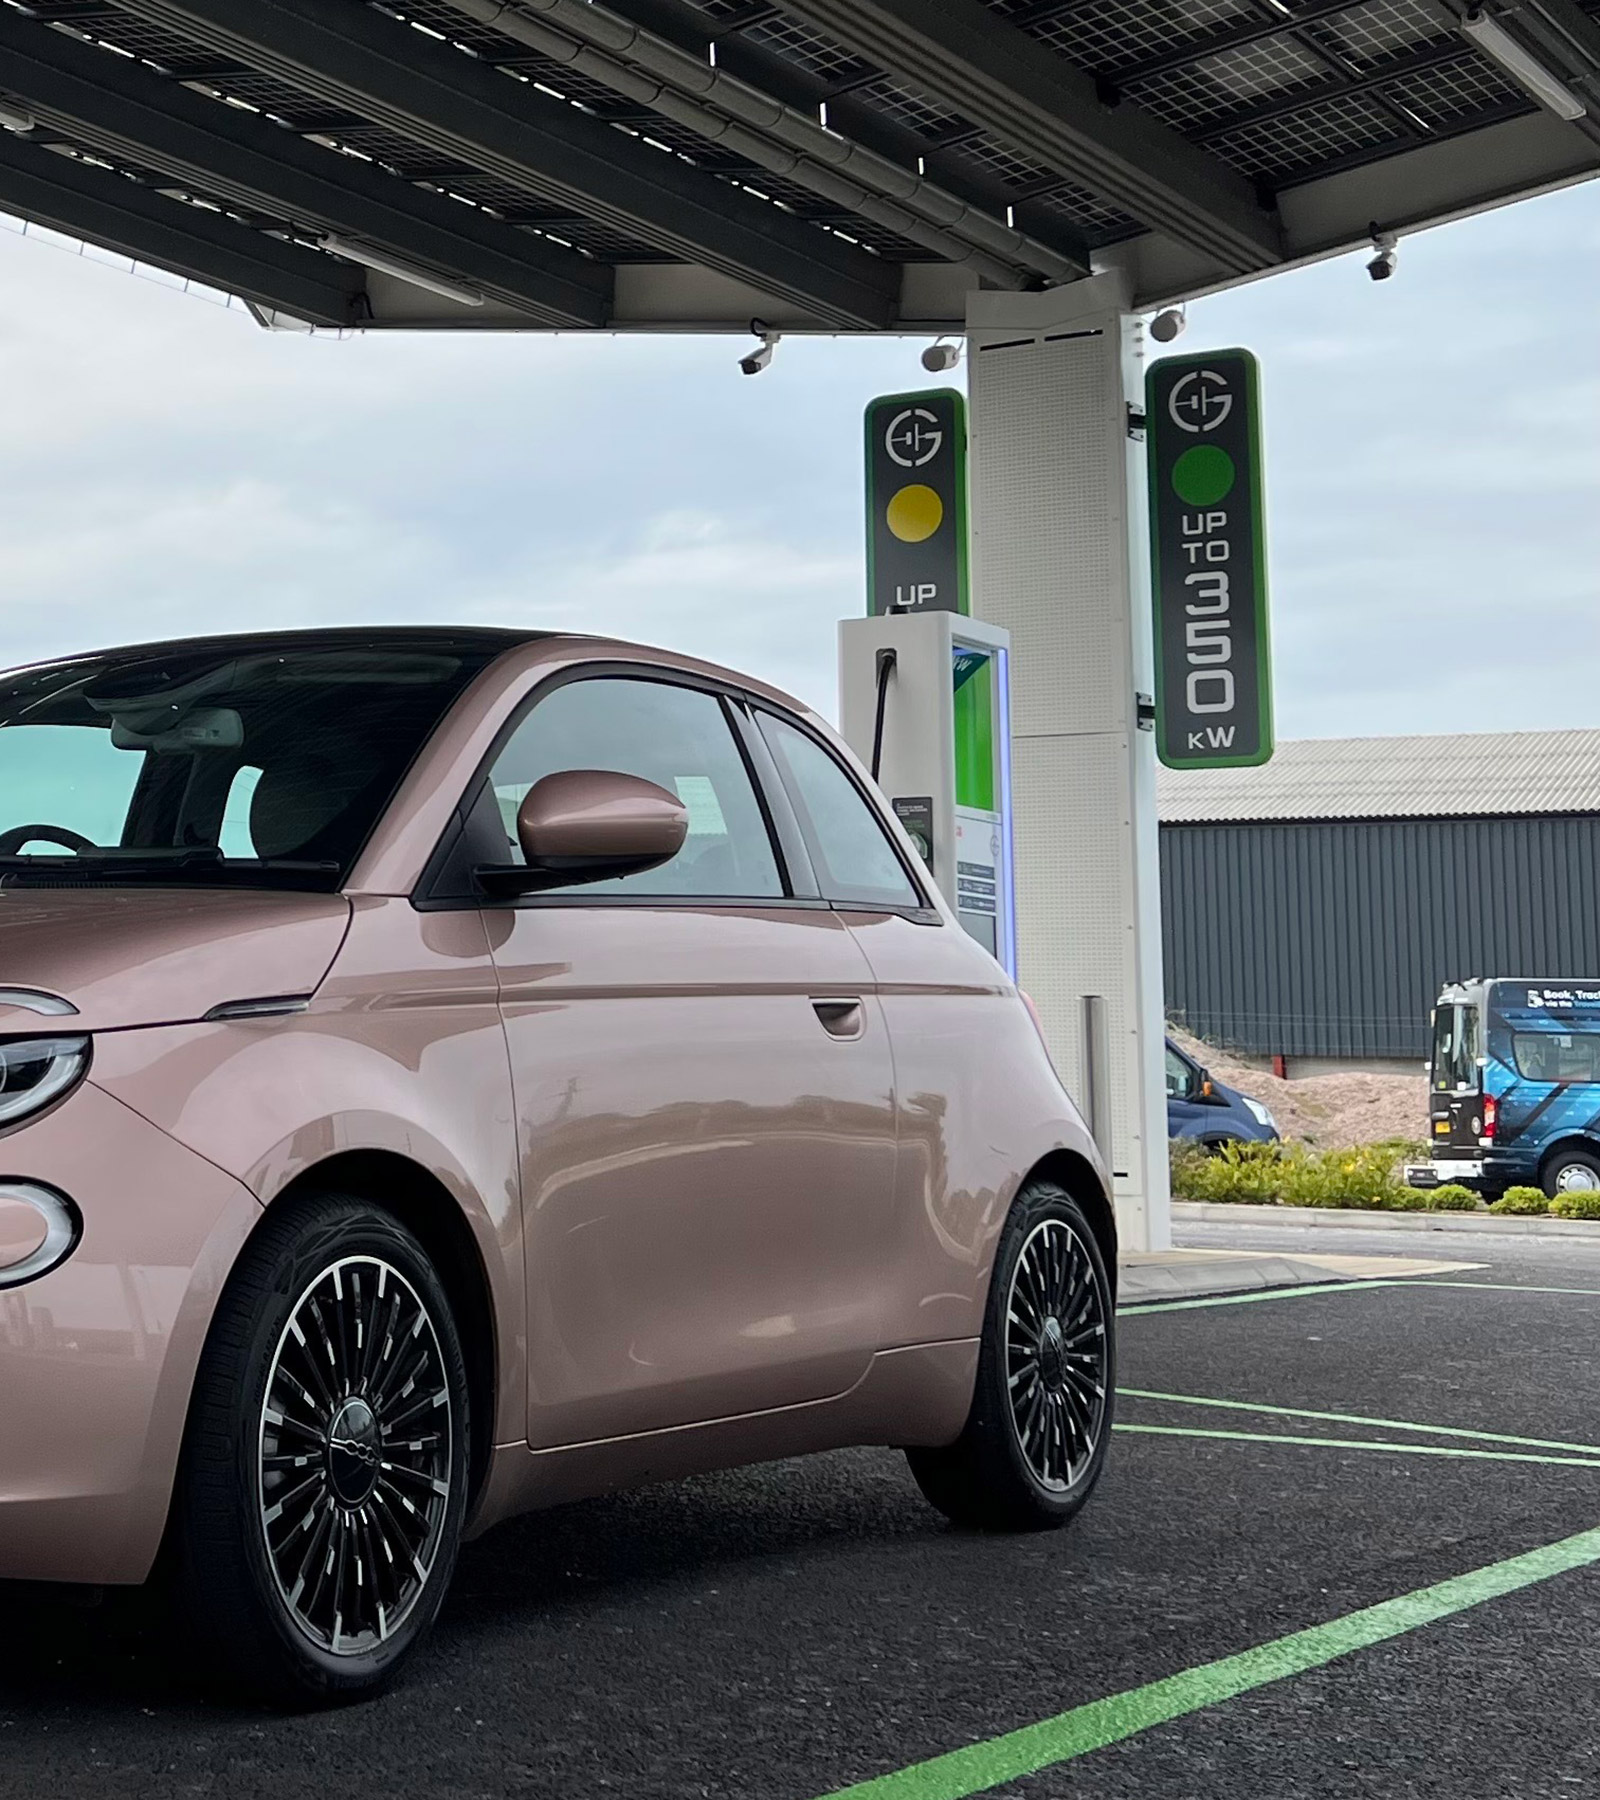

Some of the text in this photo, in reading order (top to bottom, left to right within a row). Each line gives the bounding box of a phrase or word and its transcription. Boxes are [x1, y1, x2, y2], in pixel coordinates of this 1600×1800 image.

[1182, 512, 1226, 536] UP
[1182, 540, 1229, 564] TO
[896, 584, 936, 606] UP
[1543, 990, 1575, 1001] Book,
